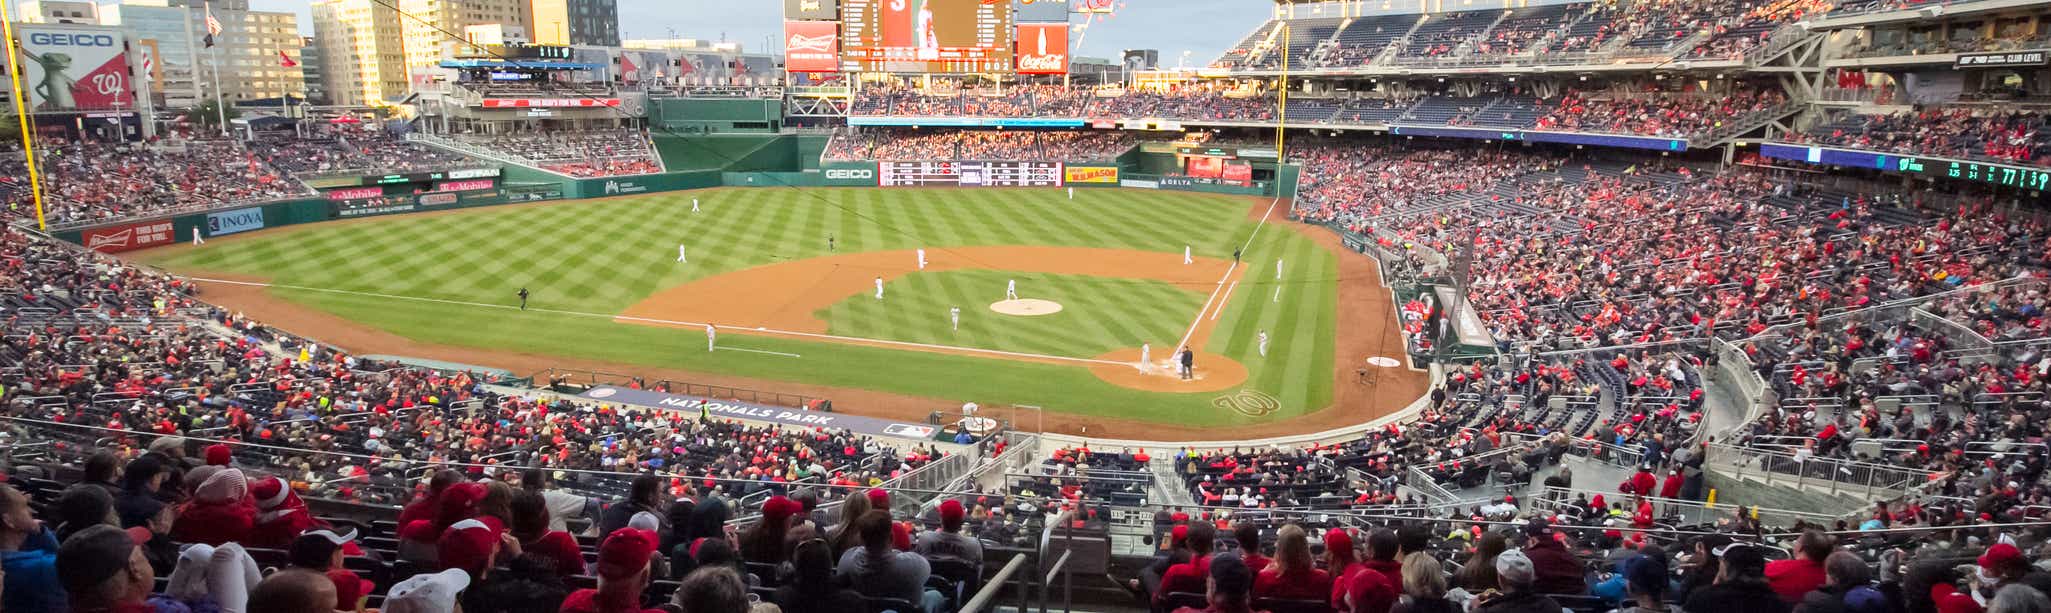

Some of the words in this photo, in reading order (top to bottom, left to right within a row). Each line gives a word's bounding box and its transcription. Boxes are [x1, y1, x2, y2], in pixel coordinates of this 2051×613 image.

[31, 33, 113, 47] GEICO
[1020, 54, 1064, 70] Coca-Cola
[2024, 53, 2042, 62] LEVEL
[825, 169, 873, 179] GEICO
[2003, 168, 2017, 185] 77
[1168, 178, 1192, 186] DELTA
[223, 212, 262, 228] INOVA
[136, 226, 151, 235] THIS
[152, 223, 173, 232] BUD'S
[137, 235, 151, 244] FOR
[659, 397, 774, 418] NATONALS
[776, 411, 834, 425] PARK
